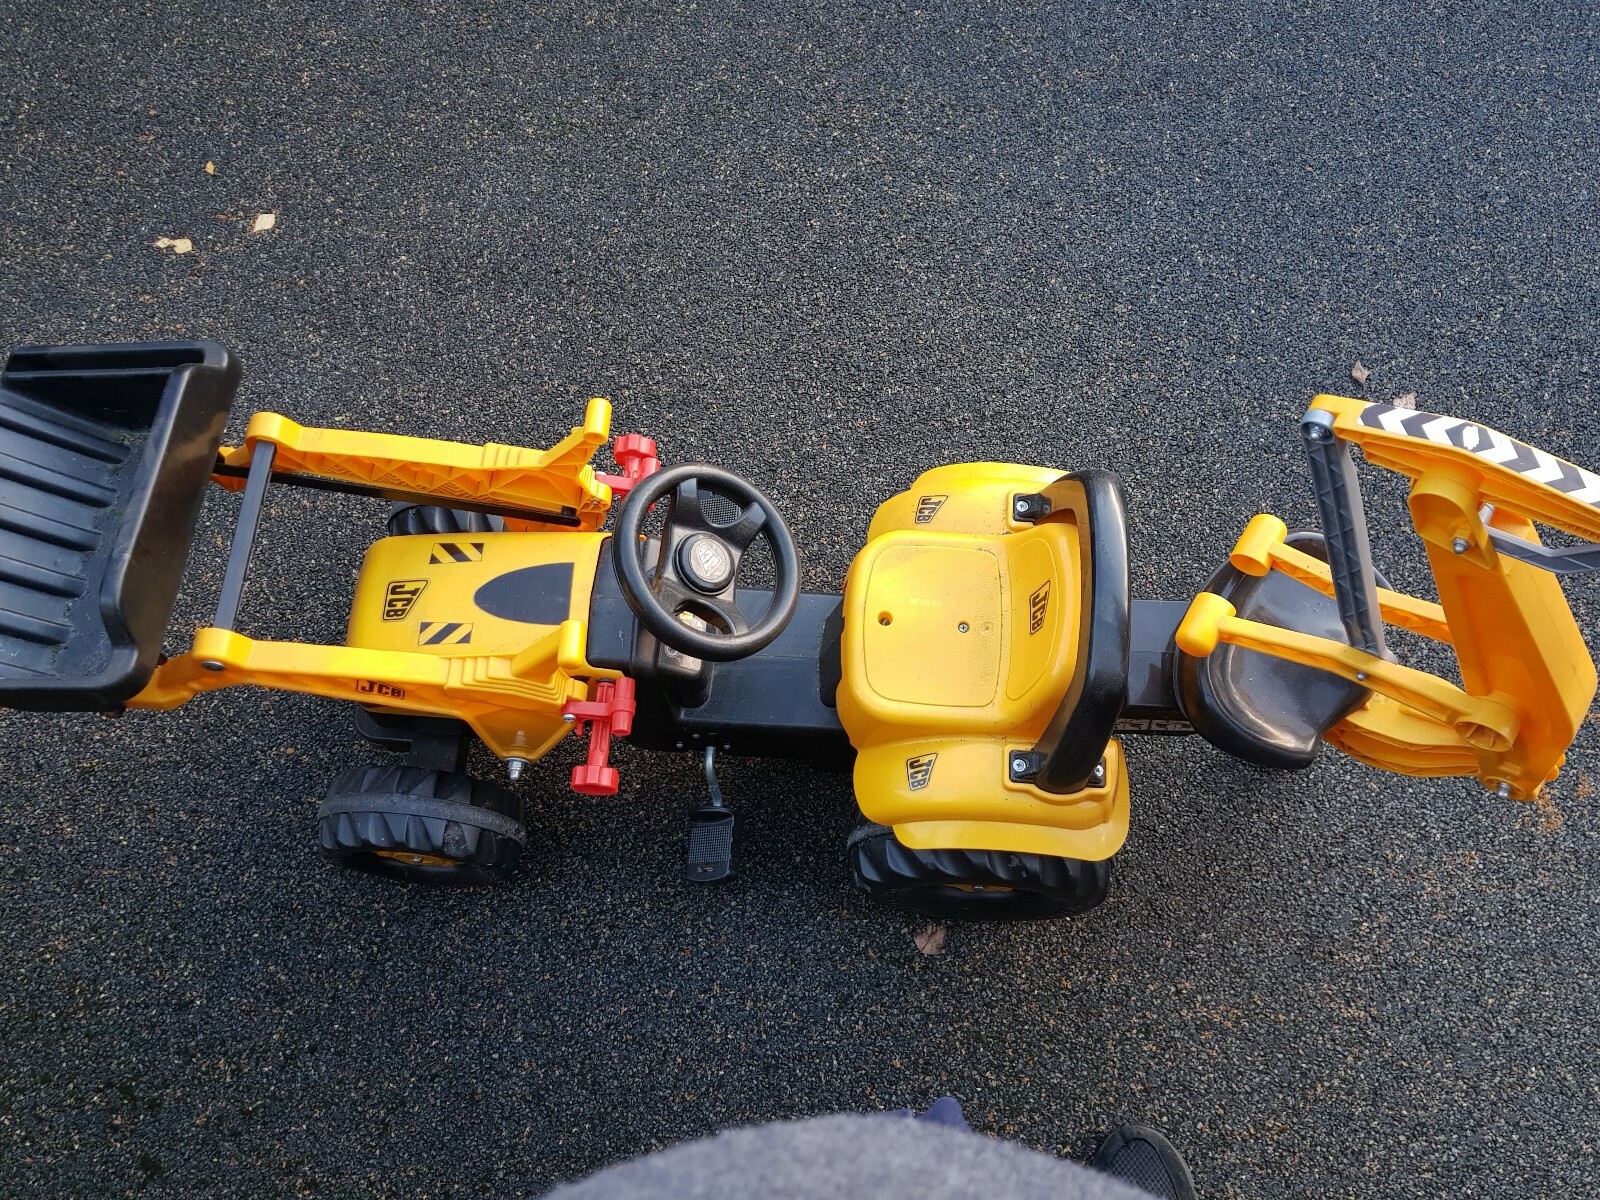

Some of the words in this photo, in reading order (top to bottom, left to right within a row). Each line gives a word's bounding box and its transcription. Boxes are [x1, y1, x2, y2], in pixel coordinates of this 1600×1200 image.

[917, 498, 942, 521] JCB
[386, 584, 420, 618] JCB
[1032, 589, 1048, 631] JCB
[361, 680, 404, 697] JCB
[910, 758, 933, 788] JCB
